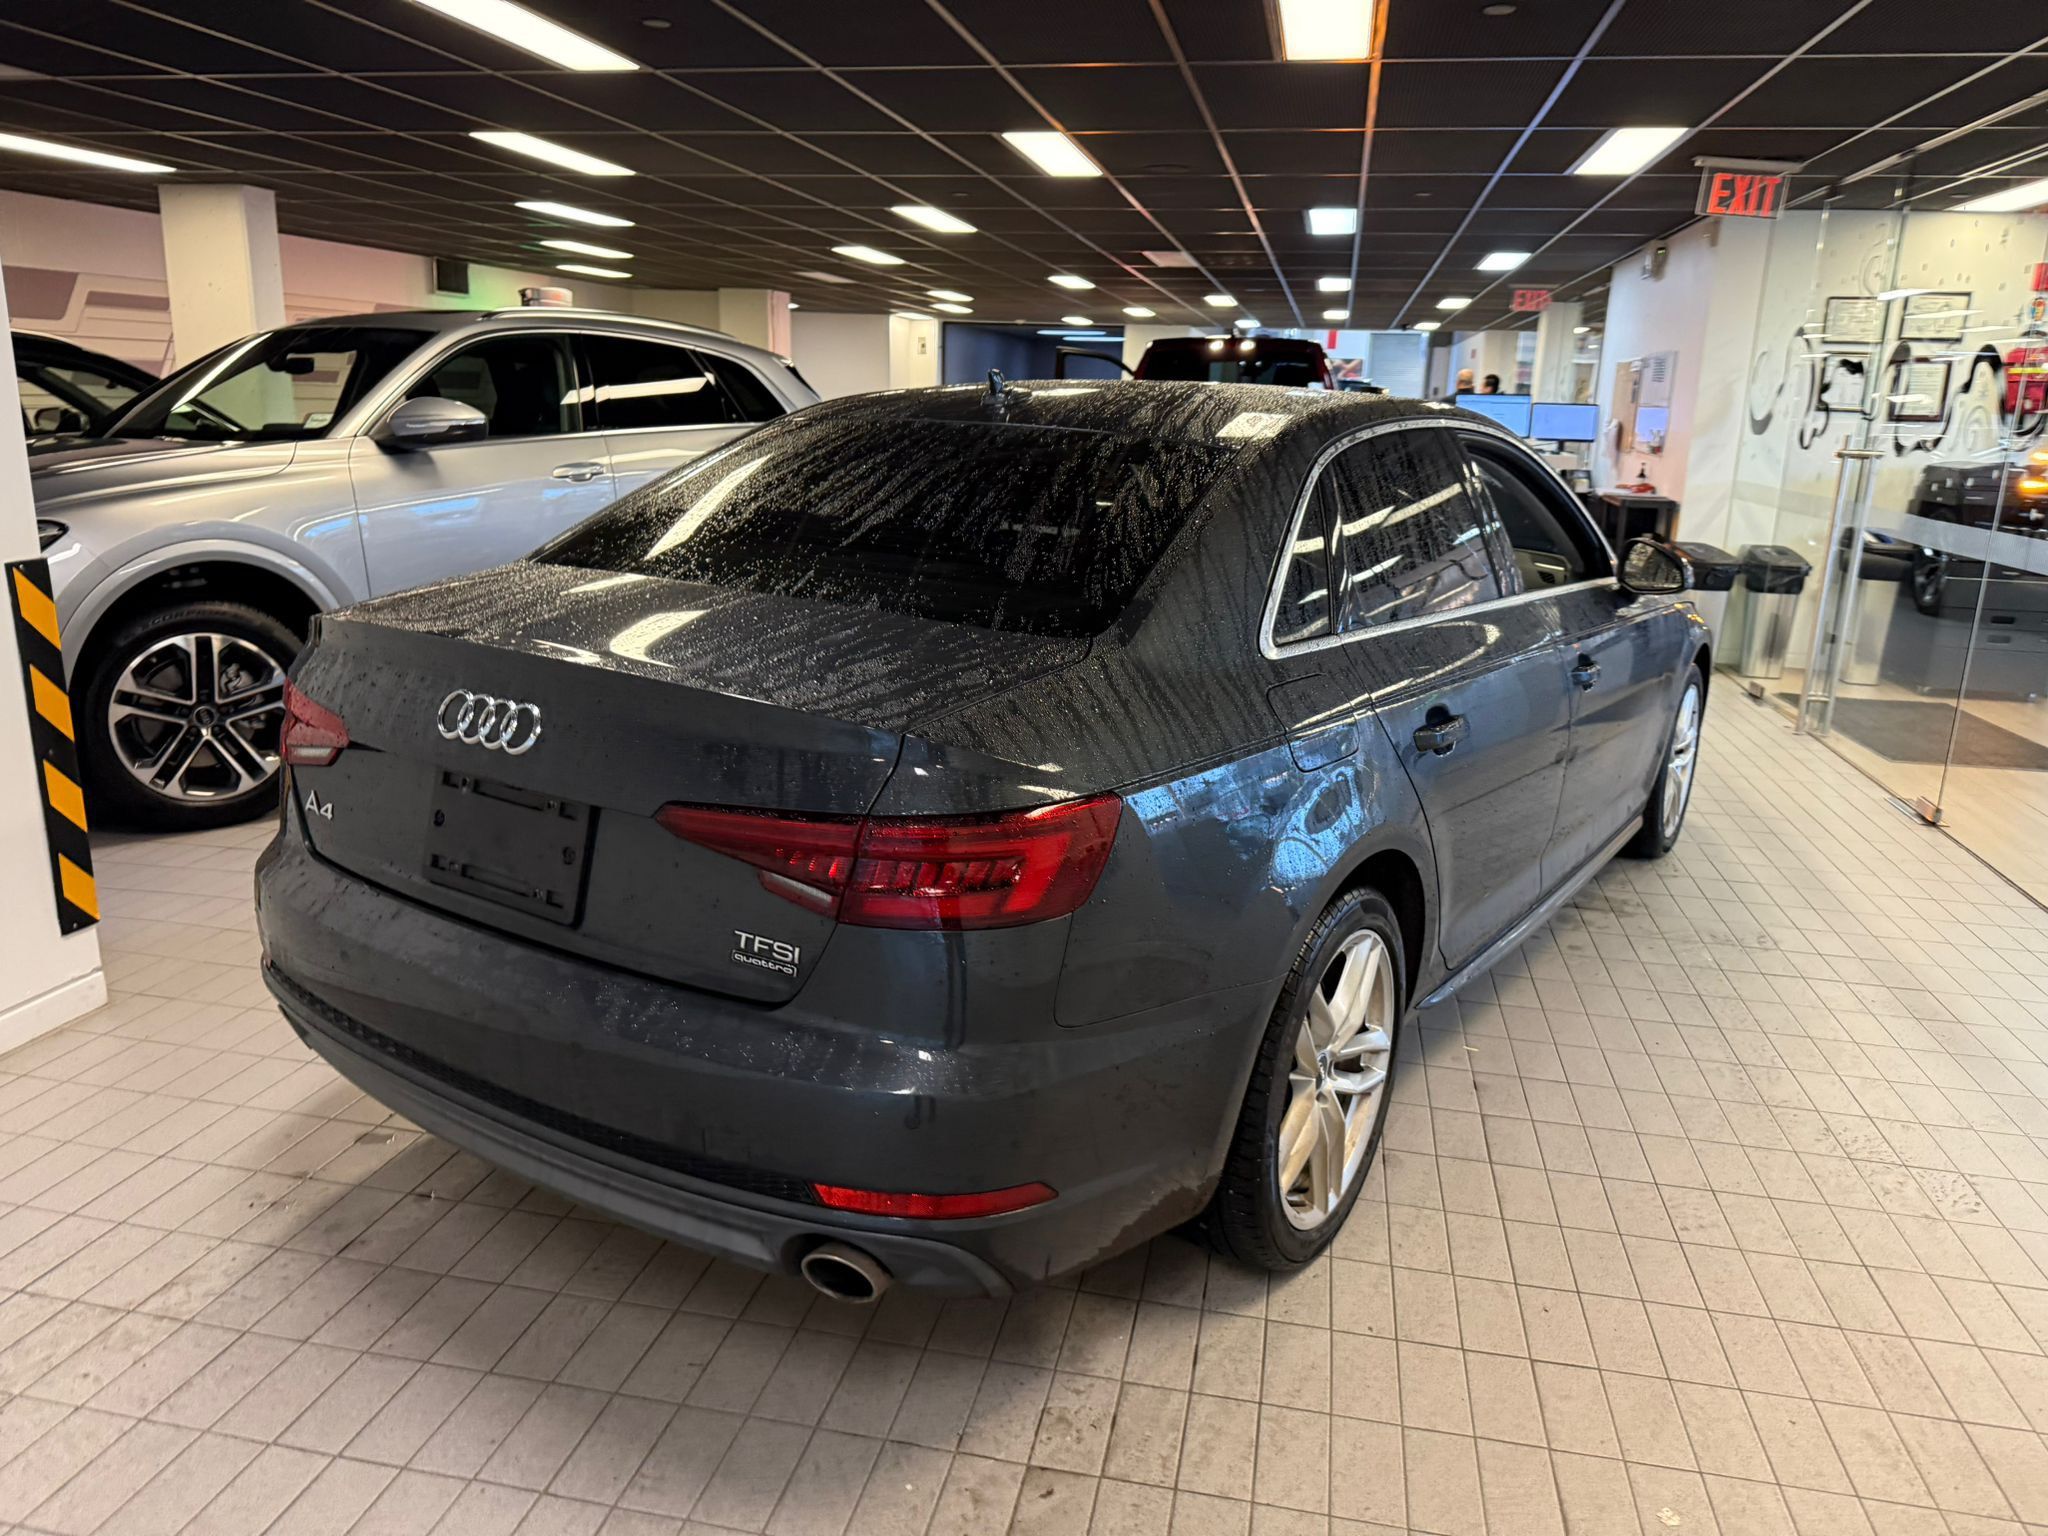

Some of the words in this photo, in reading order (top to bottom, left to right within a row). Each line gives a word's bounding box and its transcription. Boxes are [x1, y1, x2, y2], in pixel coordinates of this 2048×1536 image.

[1707, 172, 1782, 217] EXIT
[304, 789, 333, 820] A4
[734, 930, 801, 964] TFSI
[733, 953, 794, 975] quattro
